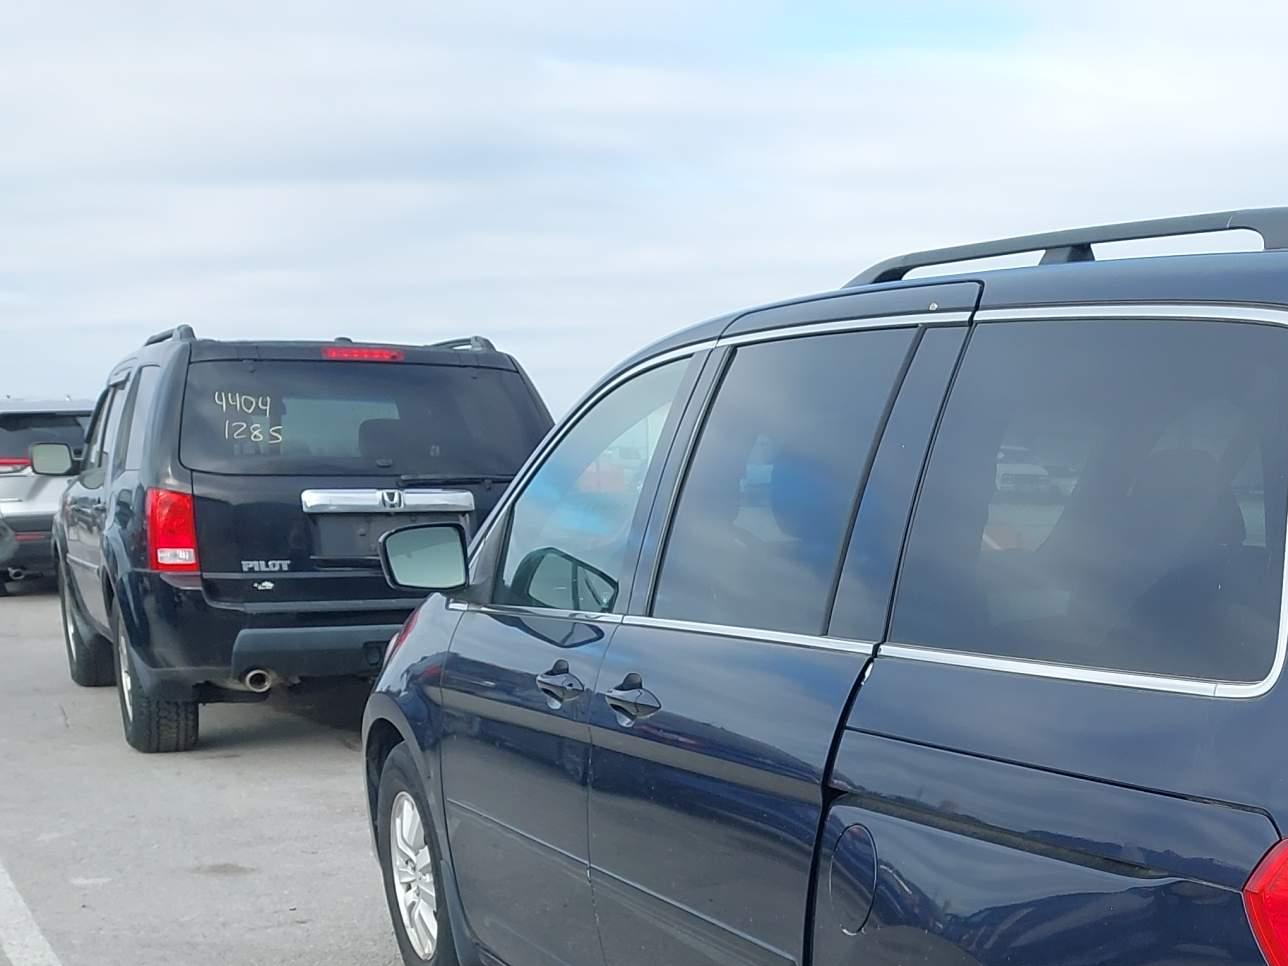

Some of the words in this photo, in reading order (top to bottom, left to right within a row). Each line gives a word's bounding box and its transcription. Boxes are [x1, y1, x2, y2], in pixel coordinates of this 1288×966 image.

[214, 391, 271, 417] 4404
[225, 420, 283, 443] 1285
[241, 560, 291, 571] PILOT
